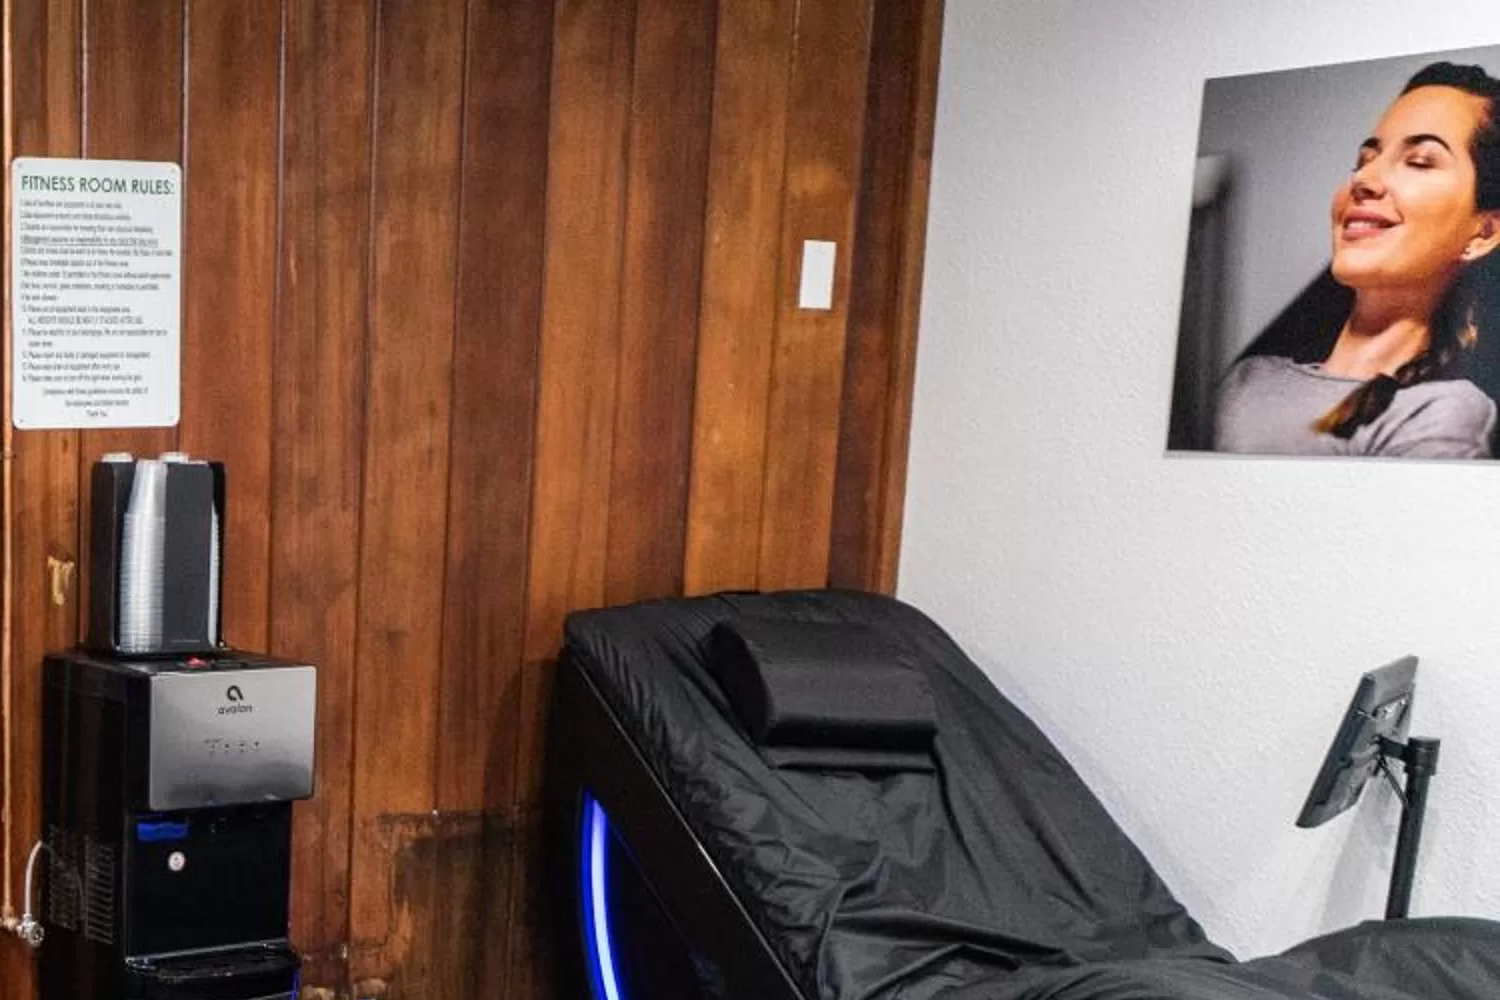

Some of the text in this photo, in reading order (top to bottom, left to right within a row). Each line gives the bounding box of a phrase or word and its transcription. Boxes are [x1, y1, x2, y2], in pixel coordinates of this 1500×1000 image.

[21, 175, 175, 195] FITNESS ROOM RULES:
